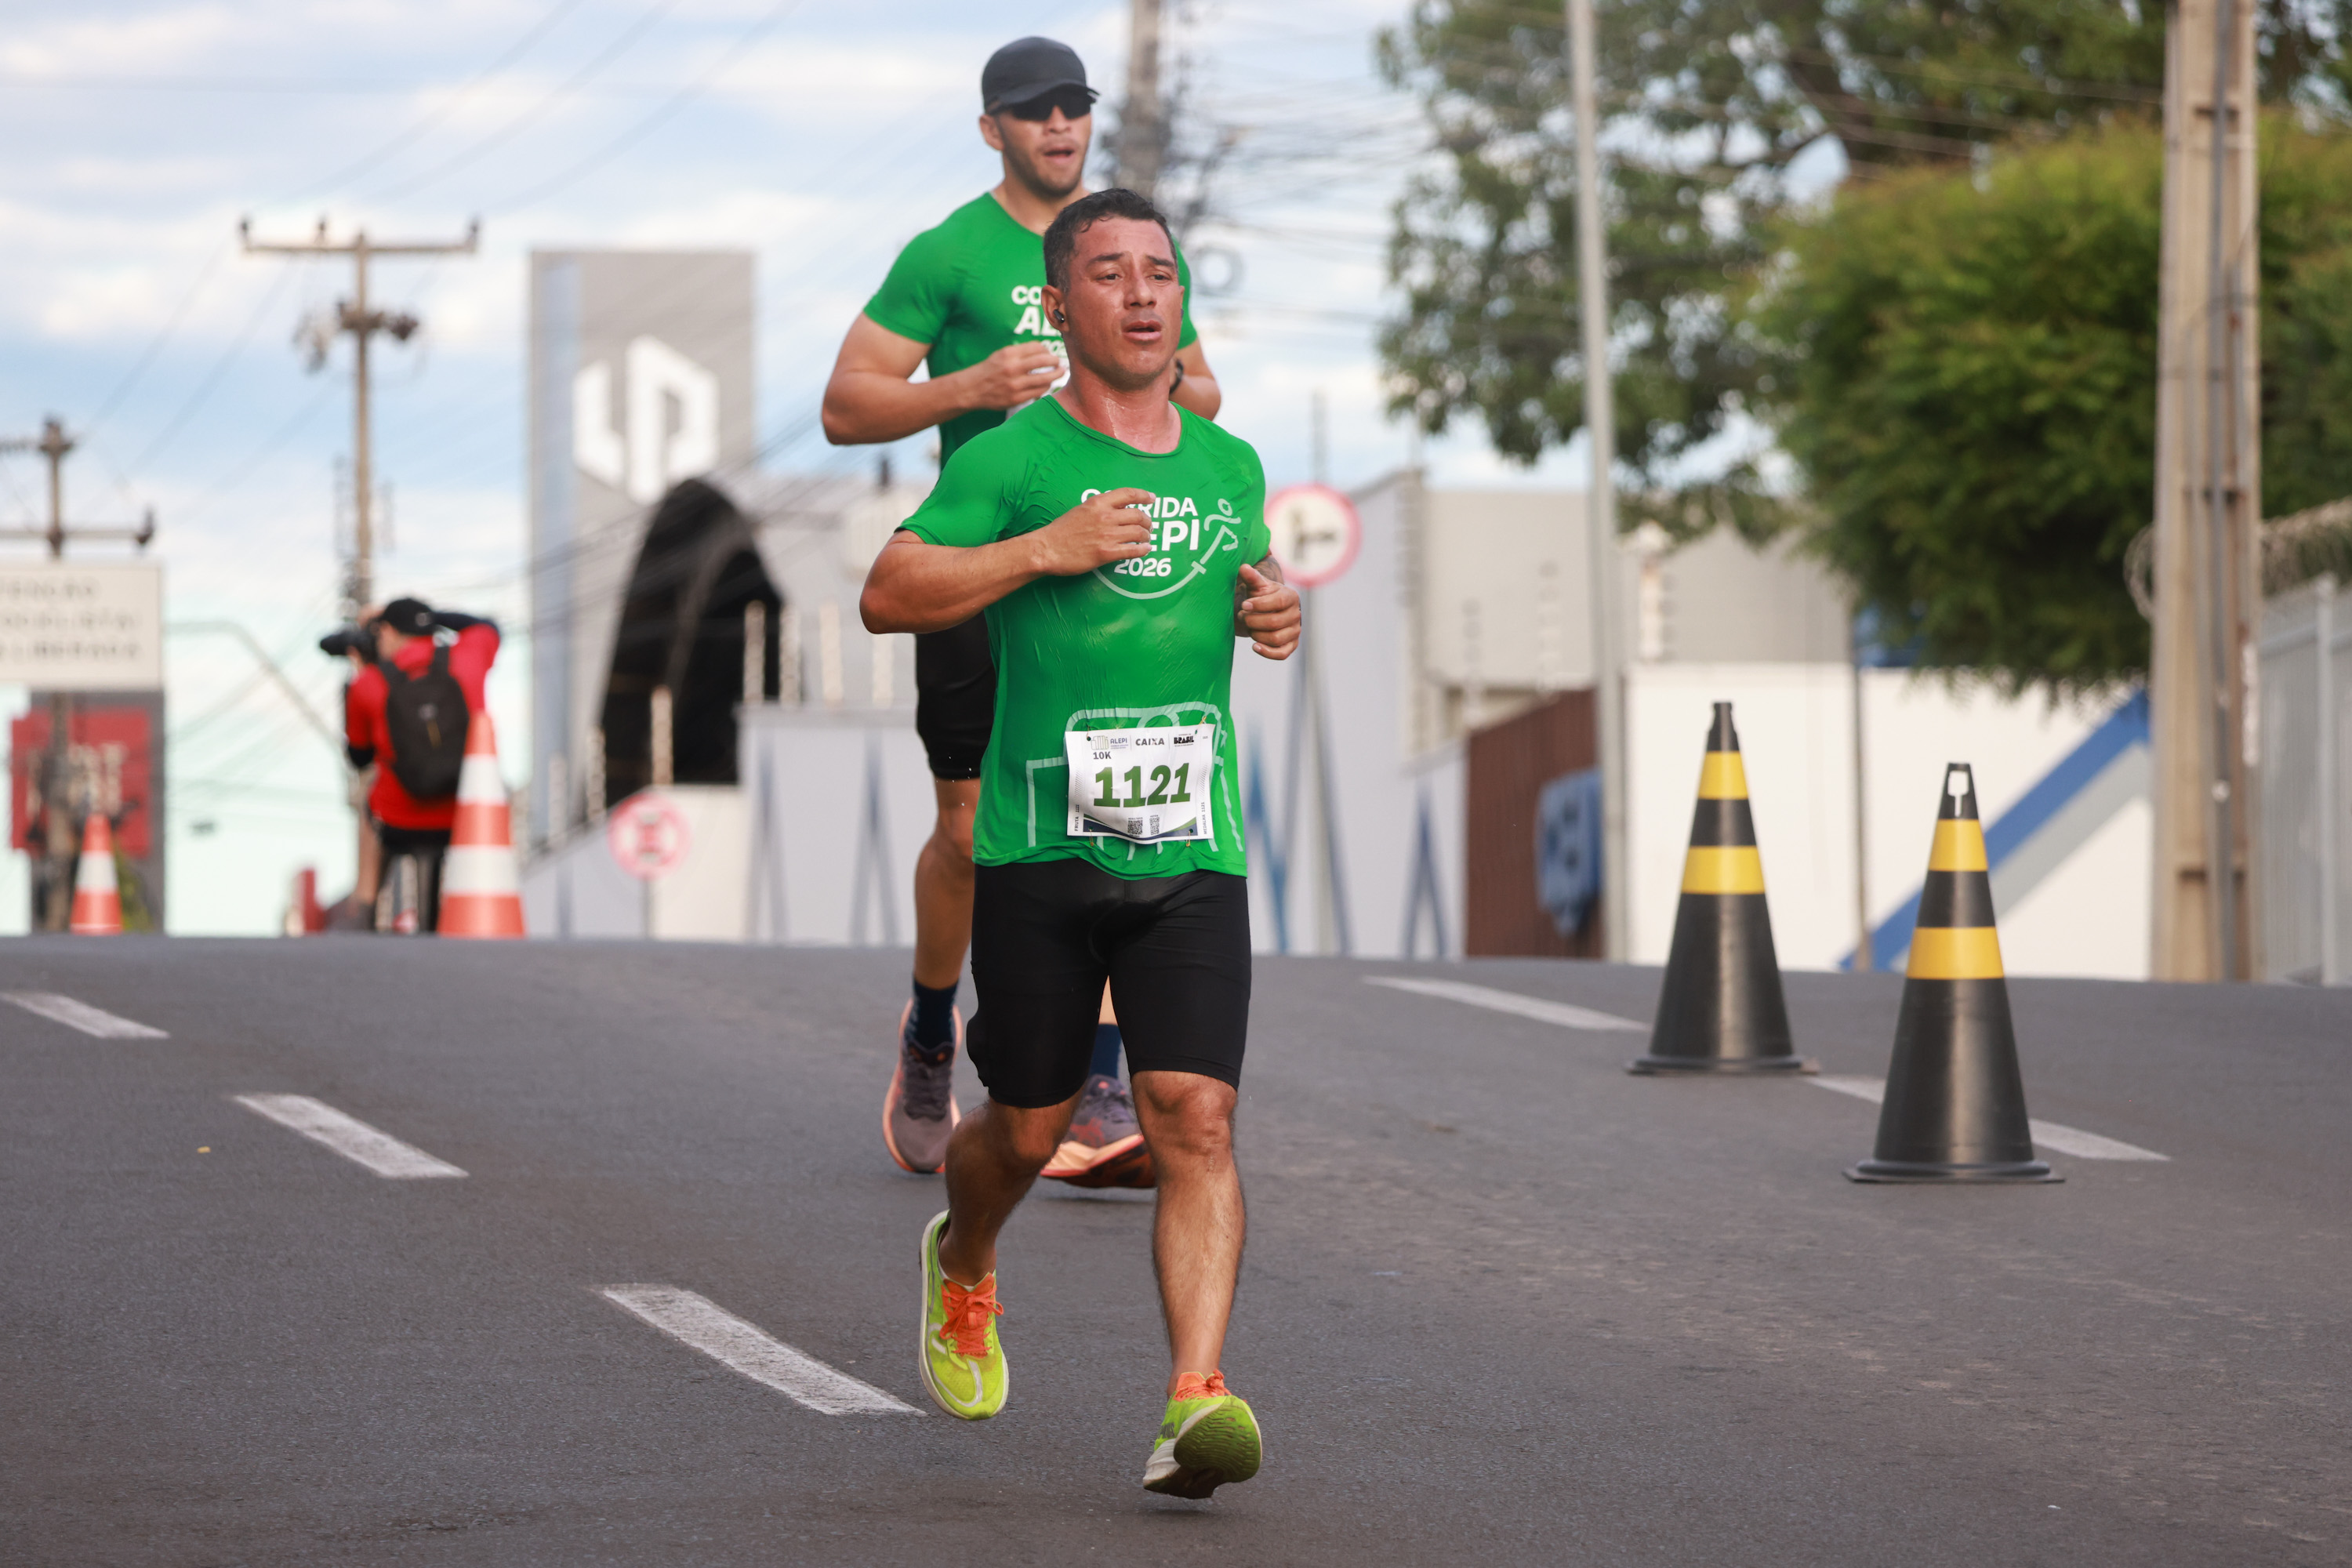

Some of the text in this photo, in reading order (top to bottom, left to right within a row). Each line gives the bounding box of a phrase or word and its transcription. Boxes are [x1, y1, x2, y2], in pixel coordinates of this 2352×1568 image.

[1149, 519, 1200, 552] EPI
[1114, 557, 1171, 577] 2026
[1174, 735, 1194, 744] BRASIL
[1093, 751, 1112, 760] 10K
[1094, 762, 1191, 808] 1121
